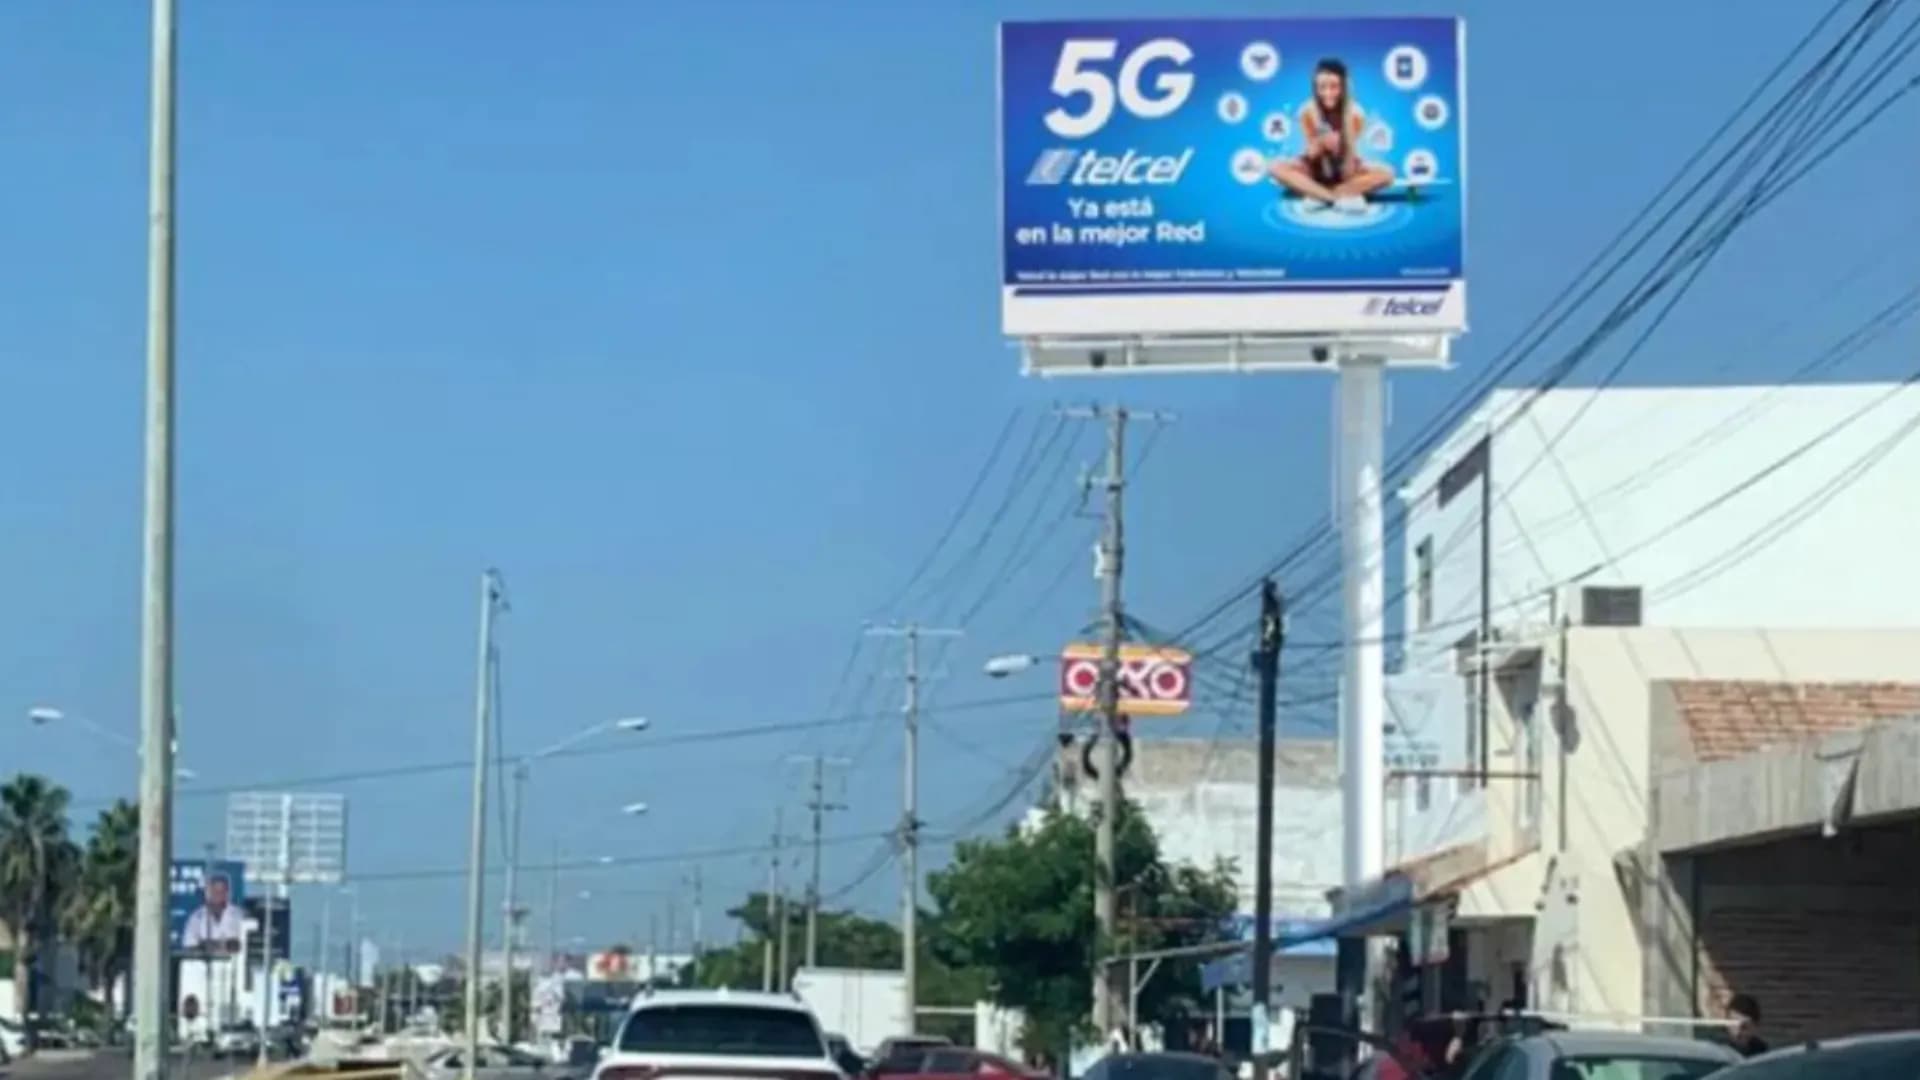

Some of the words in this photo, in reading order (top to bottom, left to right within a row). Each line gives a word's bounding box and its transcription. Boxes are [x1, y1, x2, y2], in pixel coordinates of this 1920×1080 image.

[1043, 38, 1195, 139] 5G
[1072, 148, 1194, 186] telcel
[1067, 197, 1099, 219] Ya
[1104, 196, 1153, 218] está
[1015, 227, 1046, 244] en
[1052, 222, 1073, 244] la
[1079, 222, 1149, 247] mejor
[1156, 220, 1206, 242] Red
